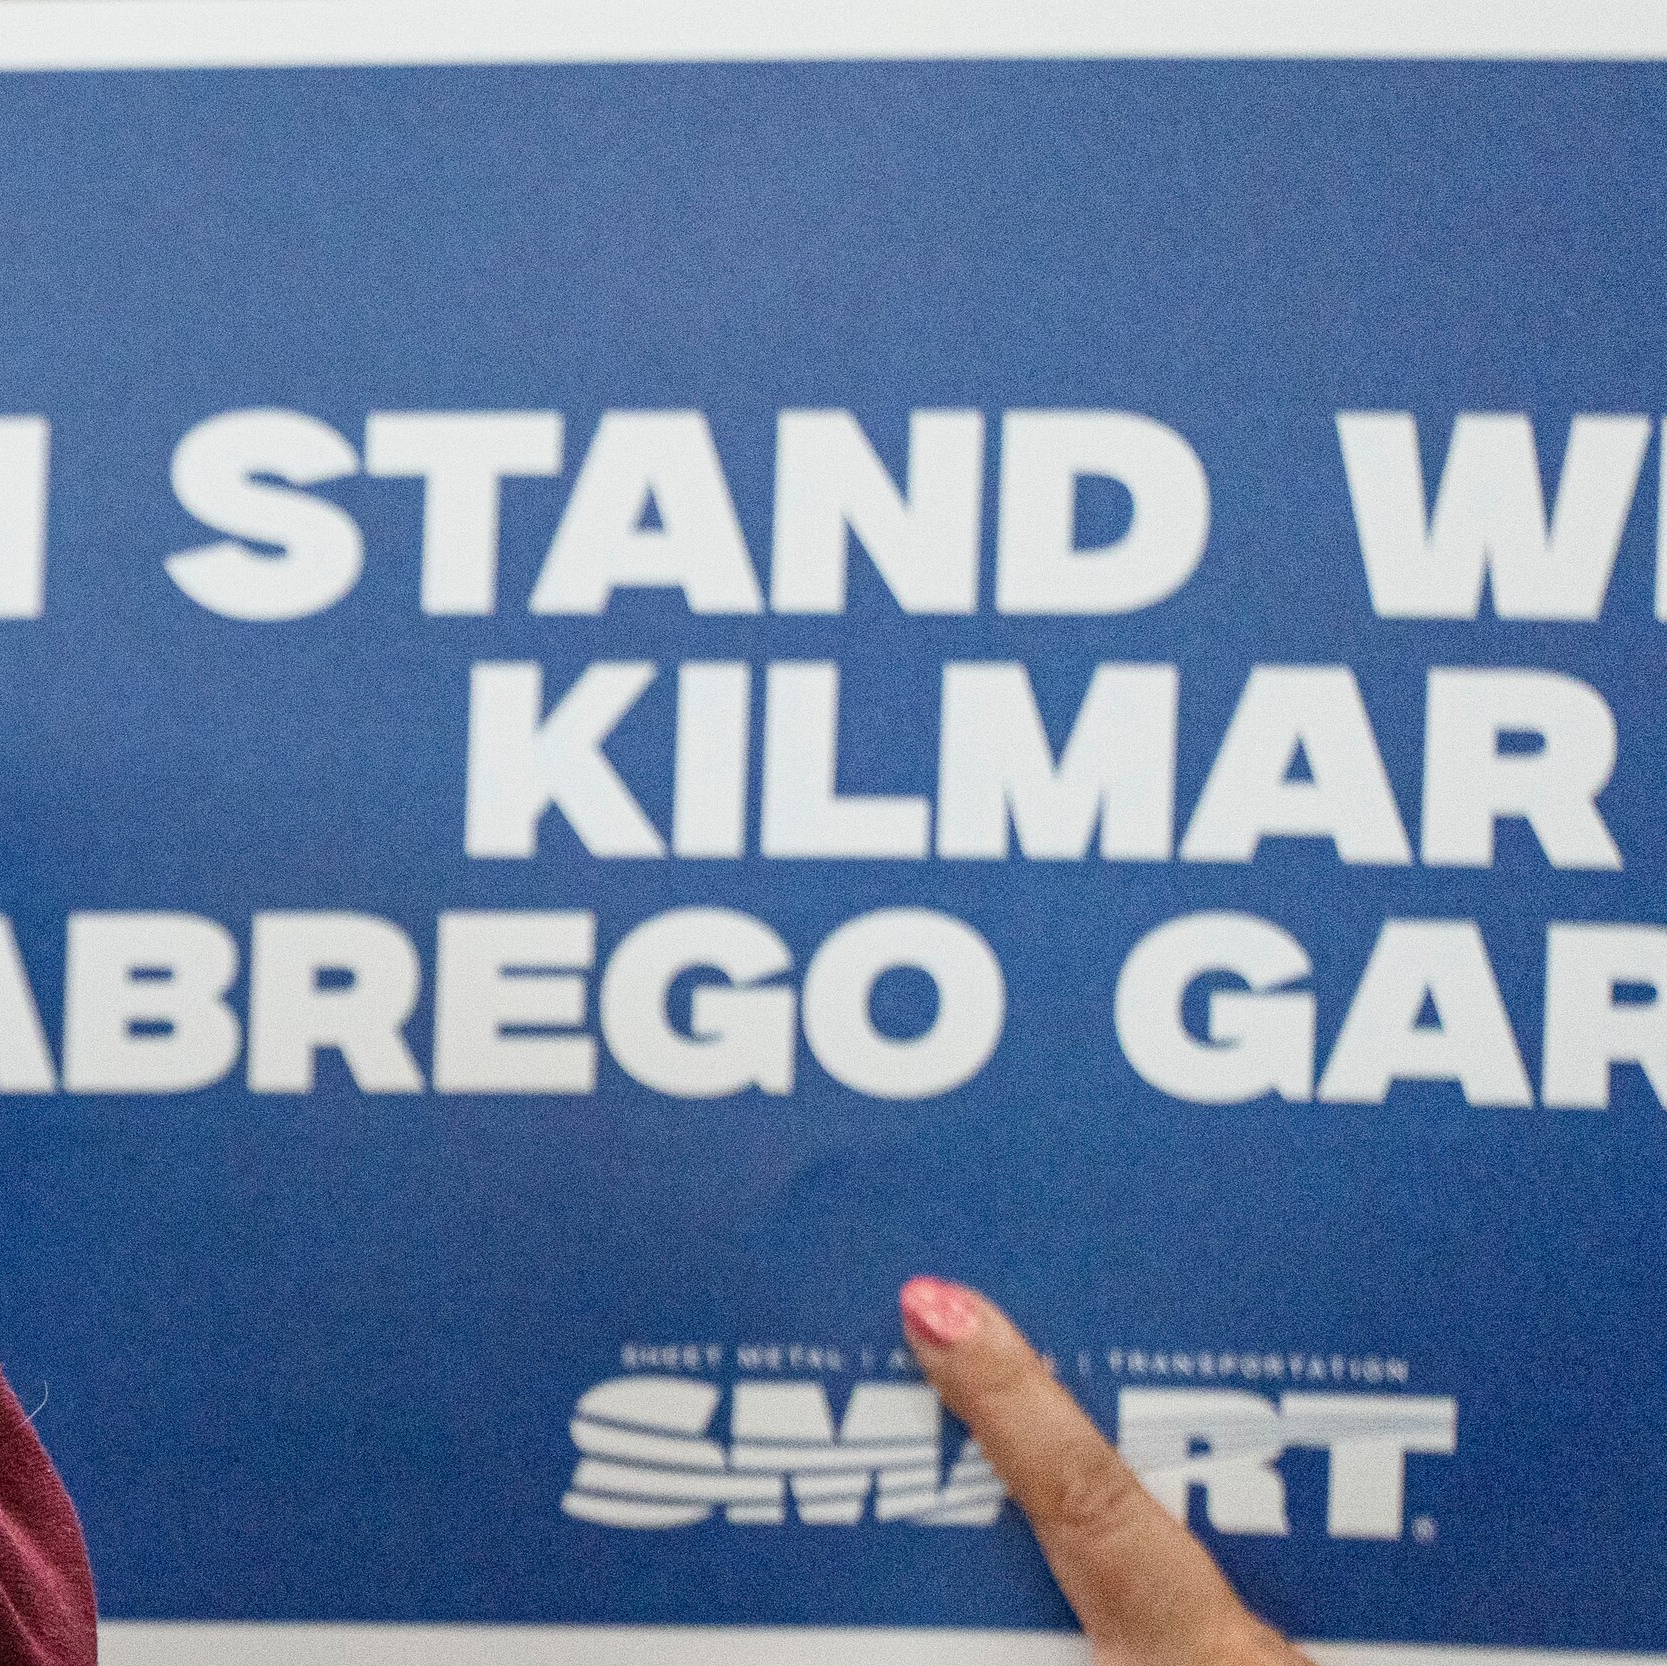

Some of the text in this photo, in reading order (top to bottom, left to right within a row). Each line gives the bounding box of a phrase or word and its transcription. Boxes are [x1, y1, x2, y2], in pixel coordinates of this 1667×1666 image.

[164, 407, 1212, 622] STAND
[463, 660, 1624, 871] KILMAR
[1108, 1347, 1410, 1384] TRANSPORTATION
